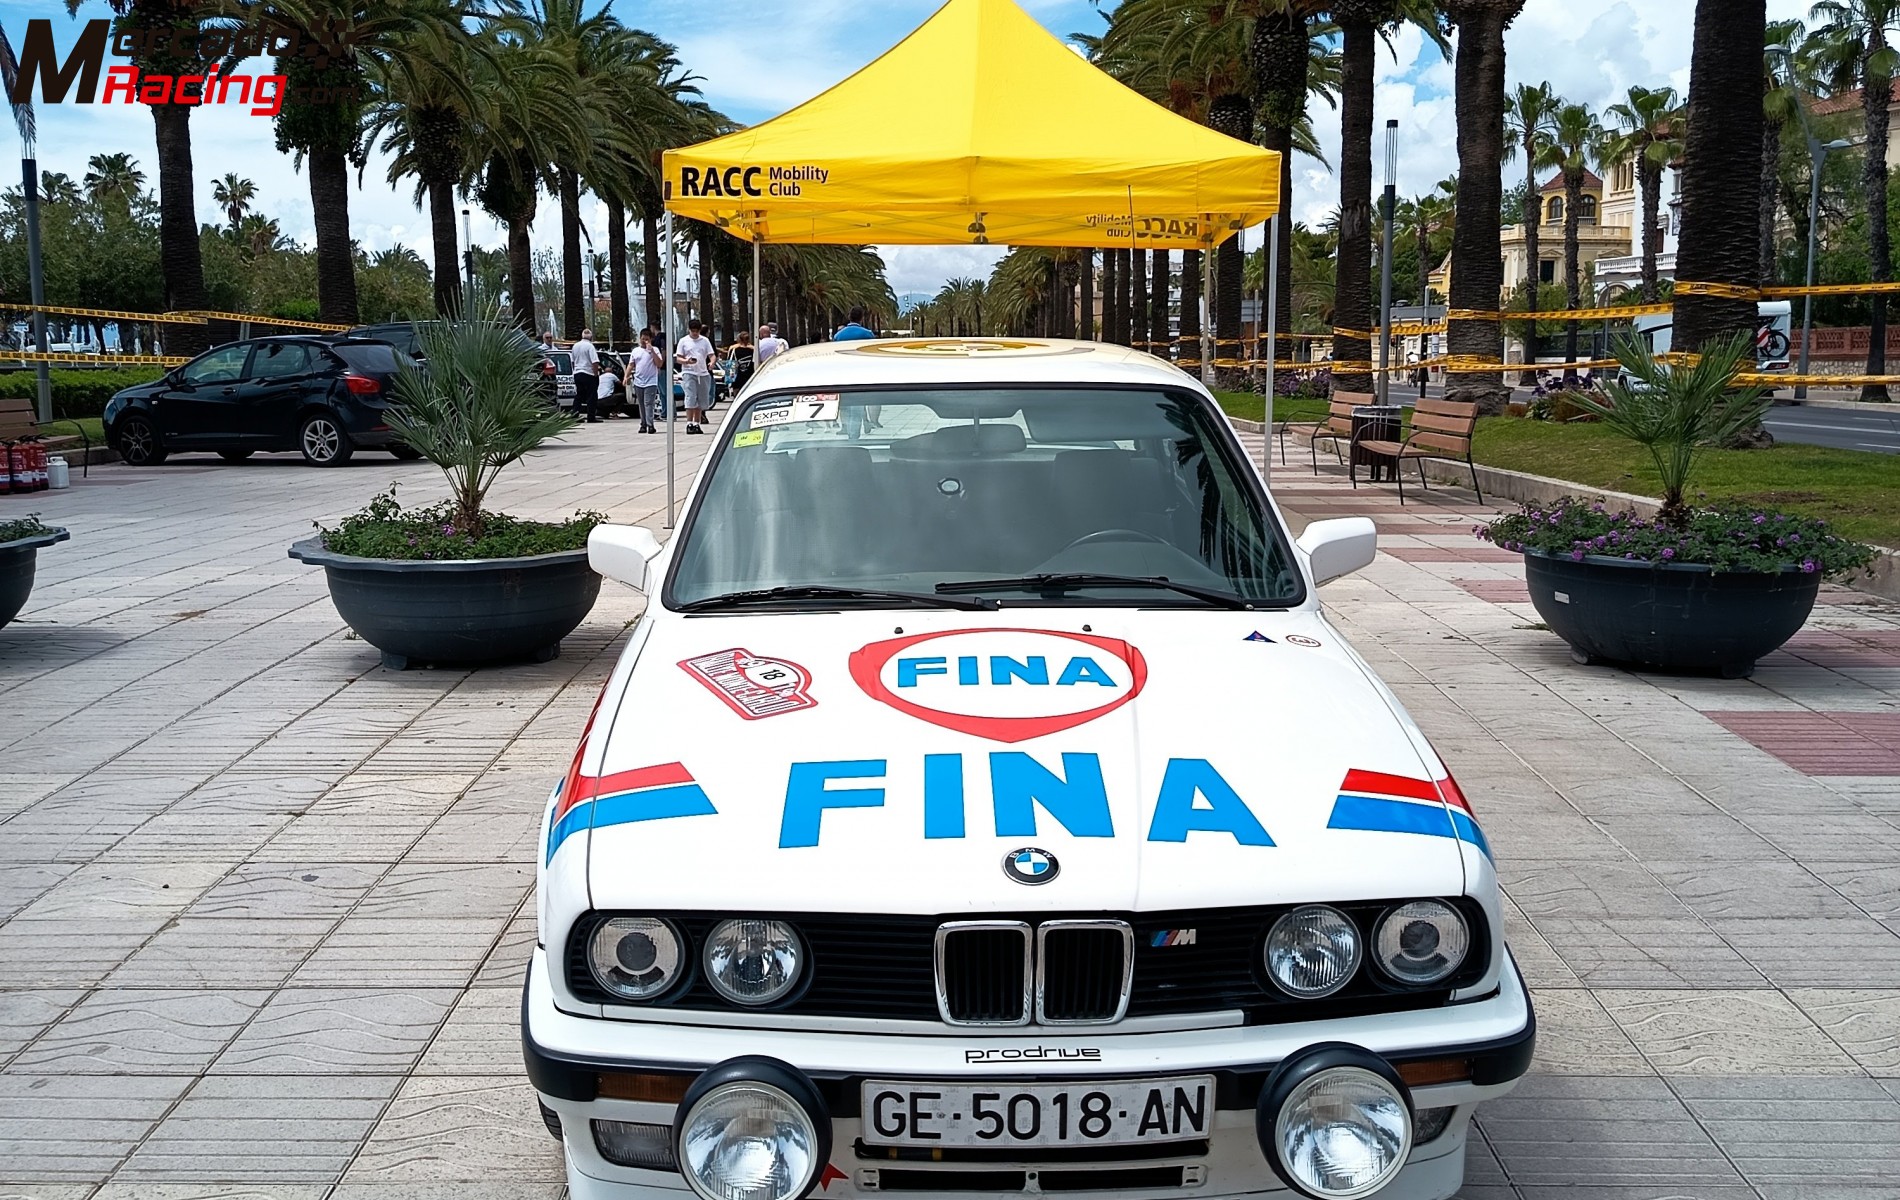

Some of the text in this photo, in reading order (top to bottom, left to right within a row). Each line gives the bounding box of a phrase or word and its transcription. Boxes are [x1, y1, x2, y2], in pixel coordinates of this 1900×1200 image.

[681, 166, 762, 197] RACC
[769, 166, 829, 184] Mobility
[769, 182, 802, 196] Club
[754, 410, 789, 421] EXPO
[808, 403, 825, 419] 7
[759, 668, 786, 681] 18
[896, 655, 1117, 689] FINA
[778, 751, 1276, 849] FINA
[1009, 848, 1053, 859] BMW
[1172, 928, 1196, 945] M
[965, 1045, 1101, 1063] prodrive
